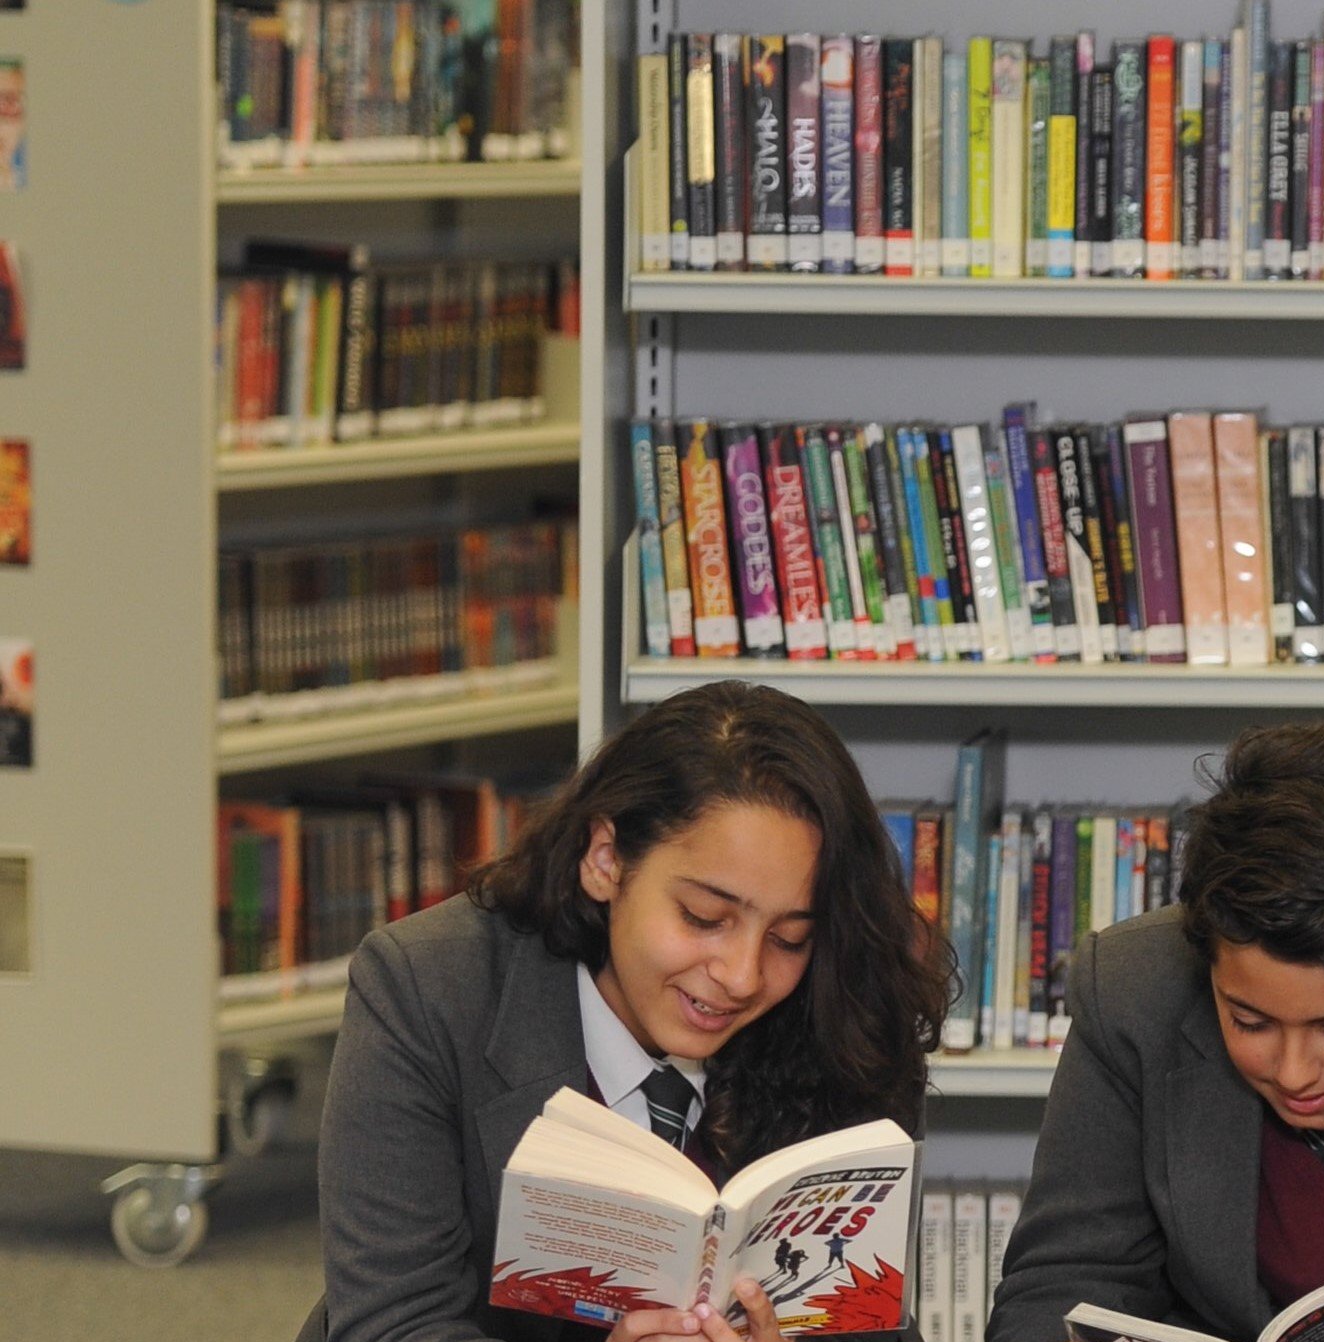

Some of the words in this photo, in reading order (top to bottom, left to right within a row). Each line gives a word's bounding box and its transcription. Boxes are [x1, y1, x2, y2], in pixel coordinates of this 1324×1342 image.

[753, 114, 781, 193] HALO
[790, 117, 817, 200] HADES
[825, 99, 852, 208] HEAVEN
[1270, 110, 1289, 155] ELLA
[1269, 155, 1289, 202] GREY
[1059, 436, 1084, 536] CLOSE-UP
[797, 1184, 853, 1208] CAN
[850, 1183, 896, 1203] BE
[847, 1165, 903, 1182] BRUTON
[728, 1205, 877, 1259] HEROES
